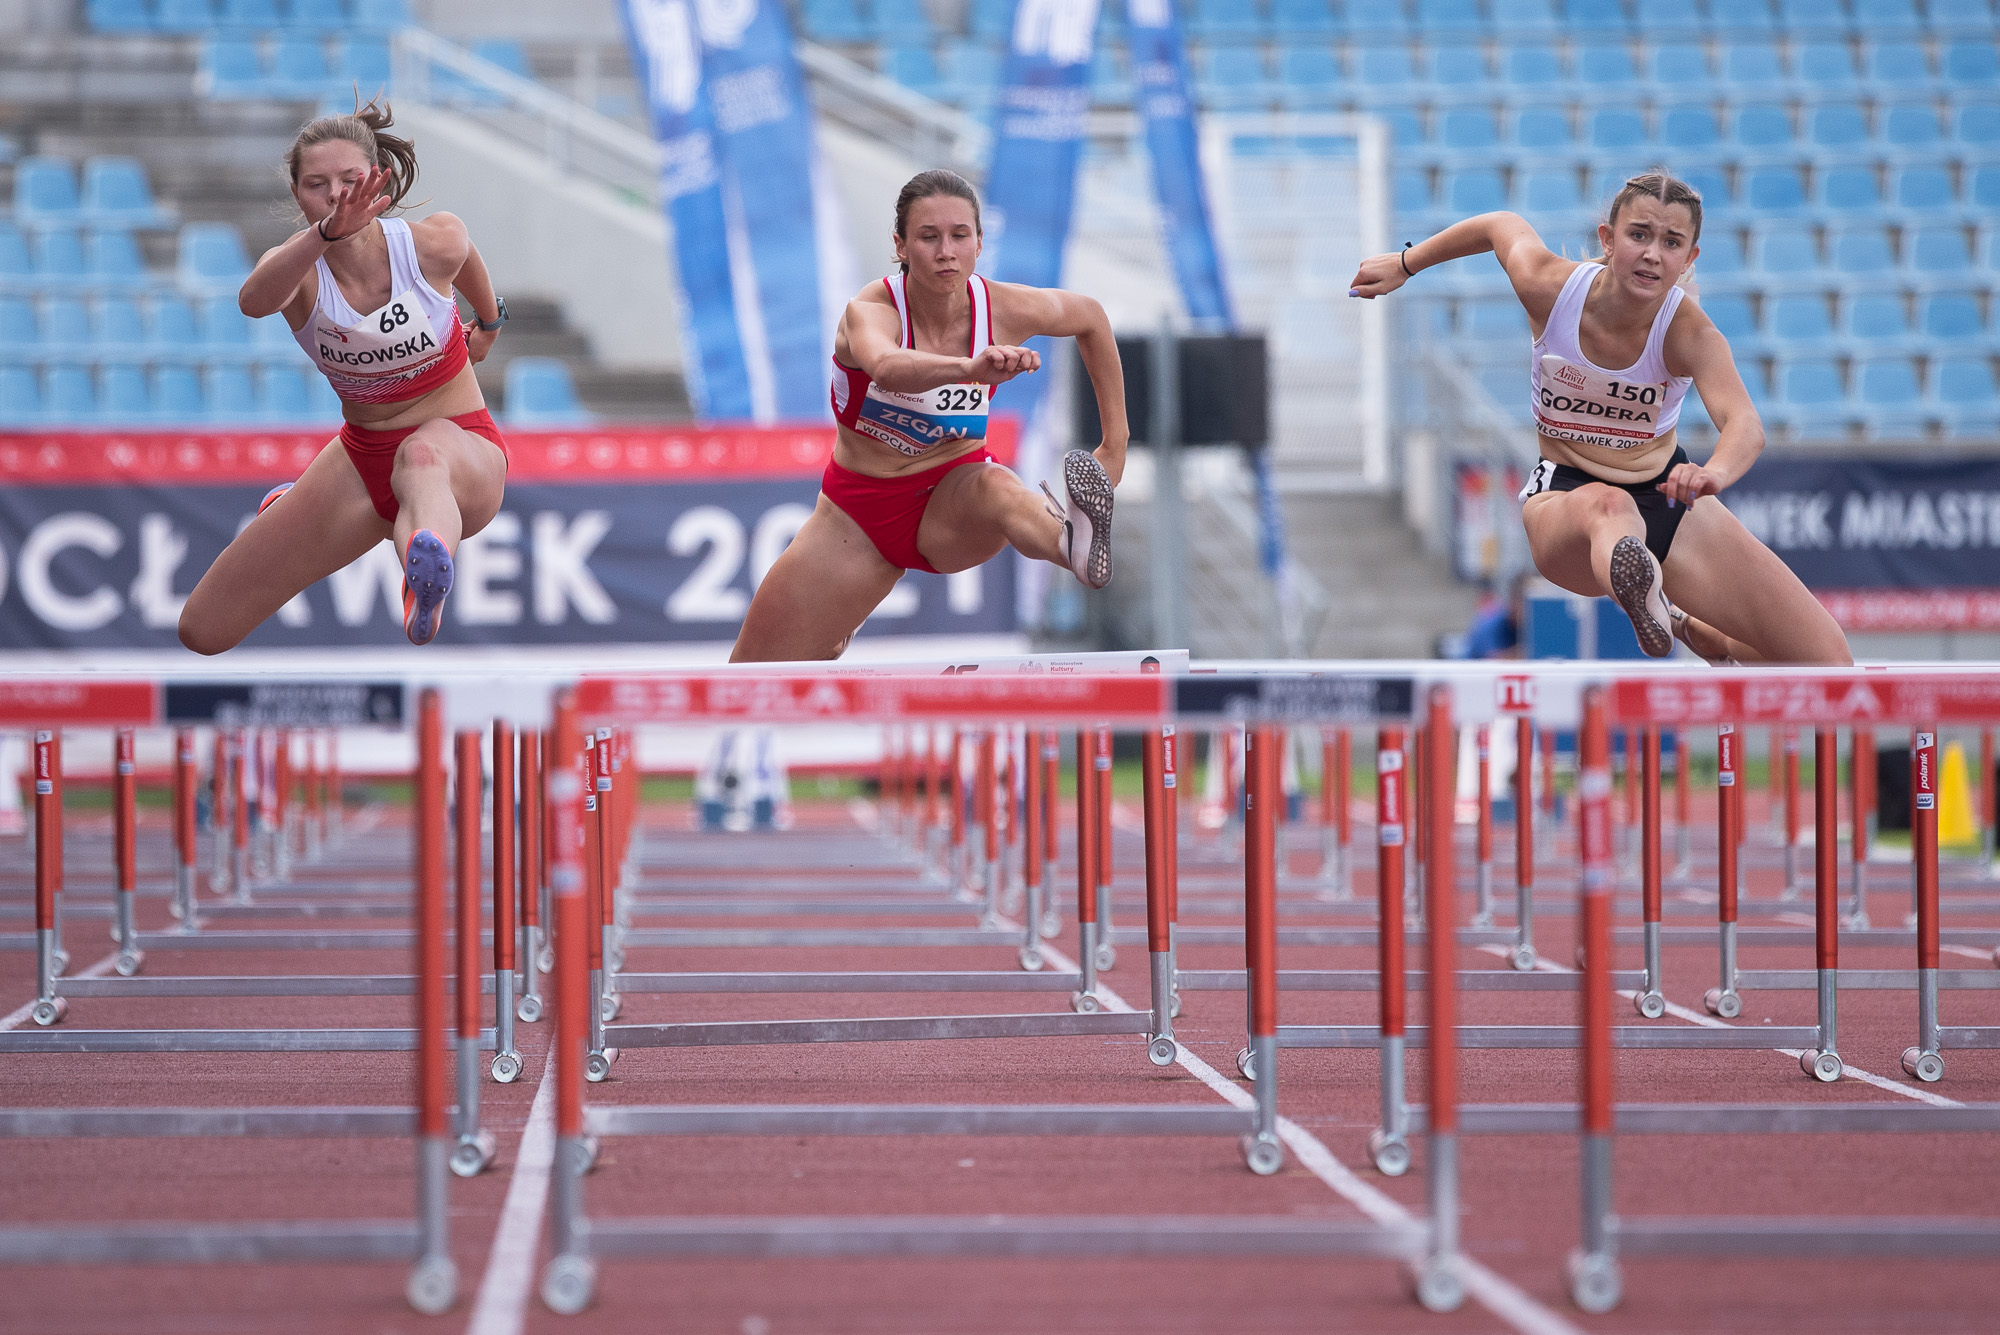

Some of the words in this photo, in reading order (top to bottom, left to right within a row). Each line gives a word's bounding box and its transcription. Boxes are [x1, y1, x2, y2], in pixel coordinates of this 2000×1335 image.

[379, 303, 410, 334] 68
[319, 331, 436, 366] RUGOWSKA
[1555, 365, 1587, 385] Anwil
[936, 388, 982, 411] 329
[1540, 387, 1652, 424] GOZDERA
[1606, 381, 1657, 405] 150
[863, 424, 926, 455] WŁOCŁAW
[879, 408, 968, 440] ZEGAN
[1536, 421, 1613, 447] WŁOCŁAWEK
[1561, 423, 1611, 434] MISTRZOSTWA
[1611, 429, 1635, 437] POLSKI
[1527, 463, 1547, 498] 3
[0, 508, 618, 632] CŁWEK
[39, 746, 50, 778] polanik
[1164, 739, 1173, 772] polanik
[1722, 737, 1731, 770] polanik
[1918, 752, 1930, 790] polanik
